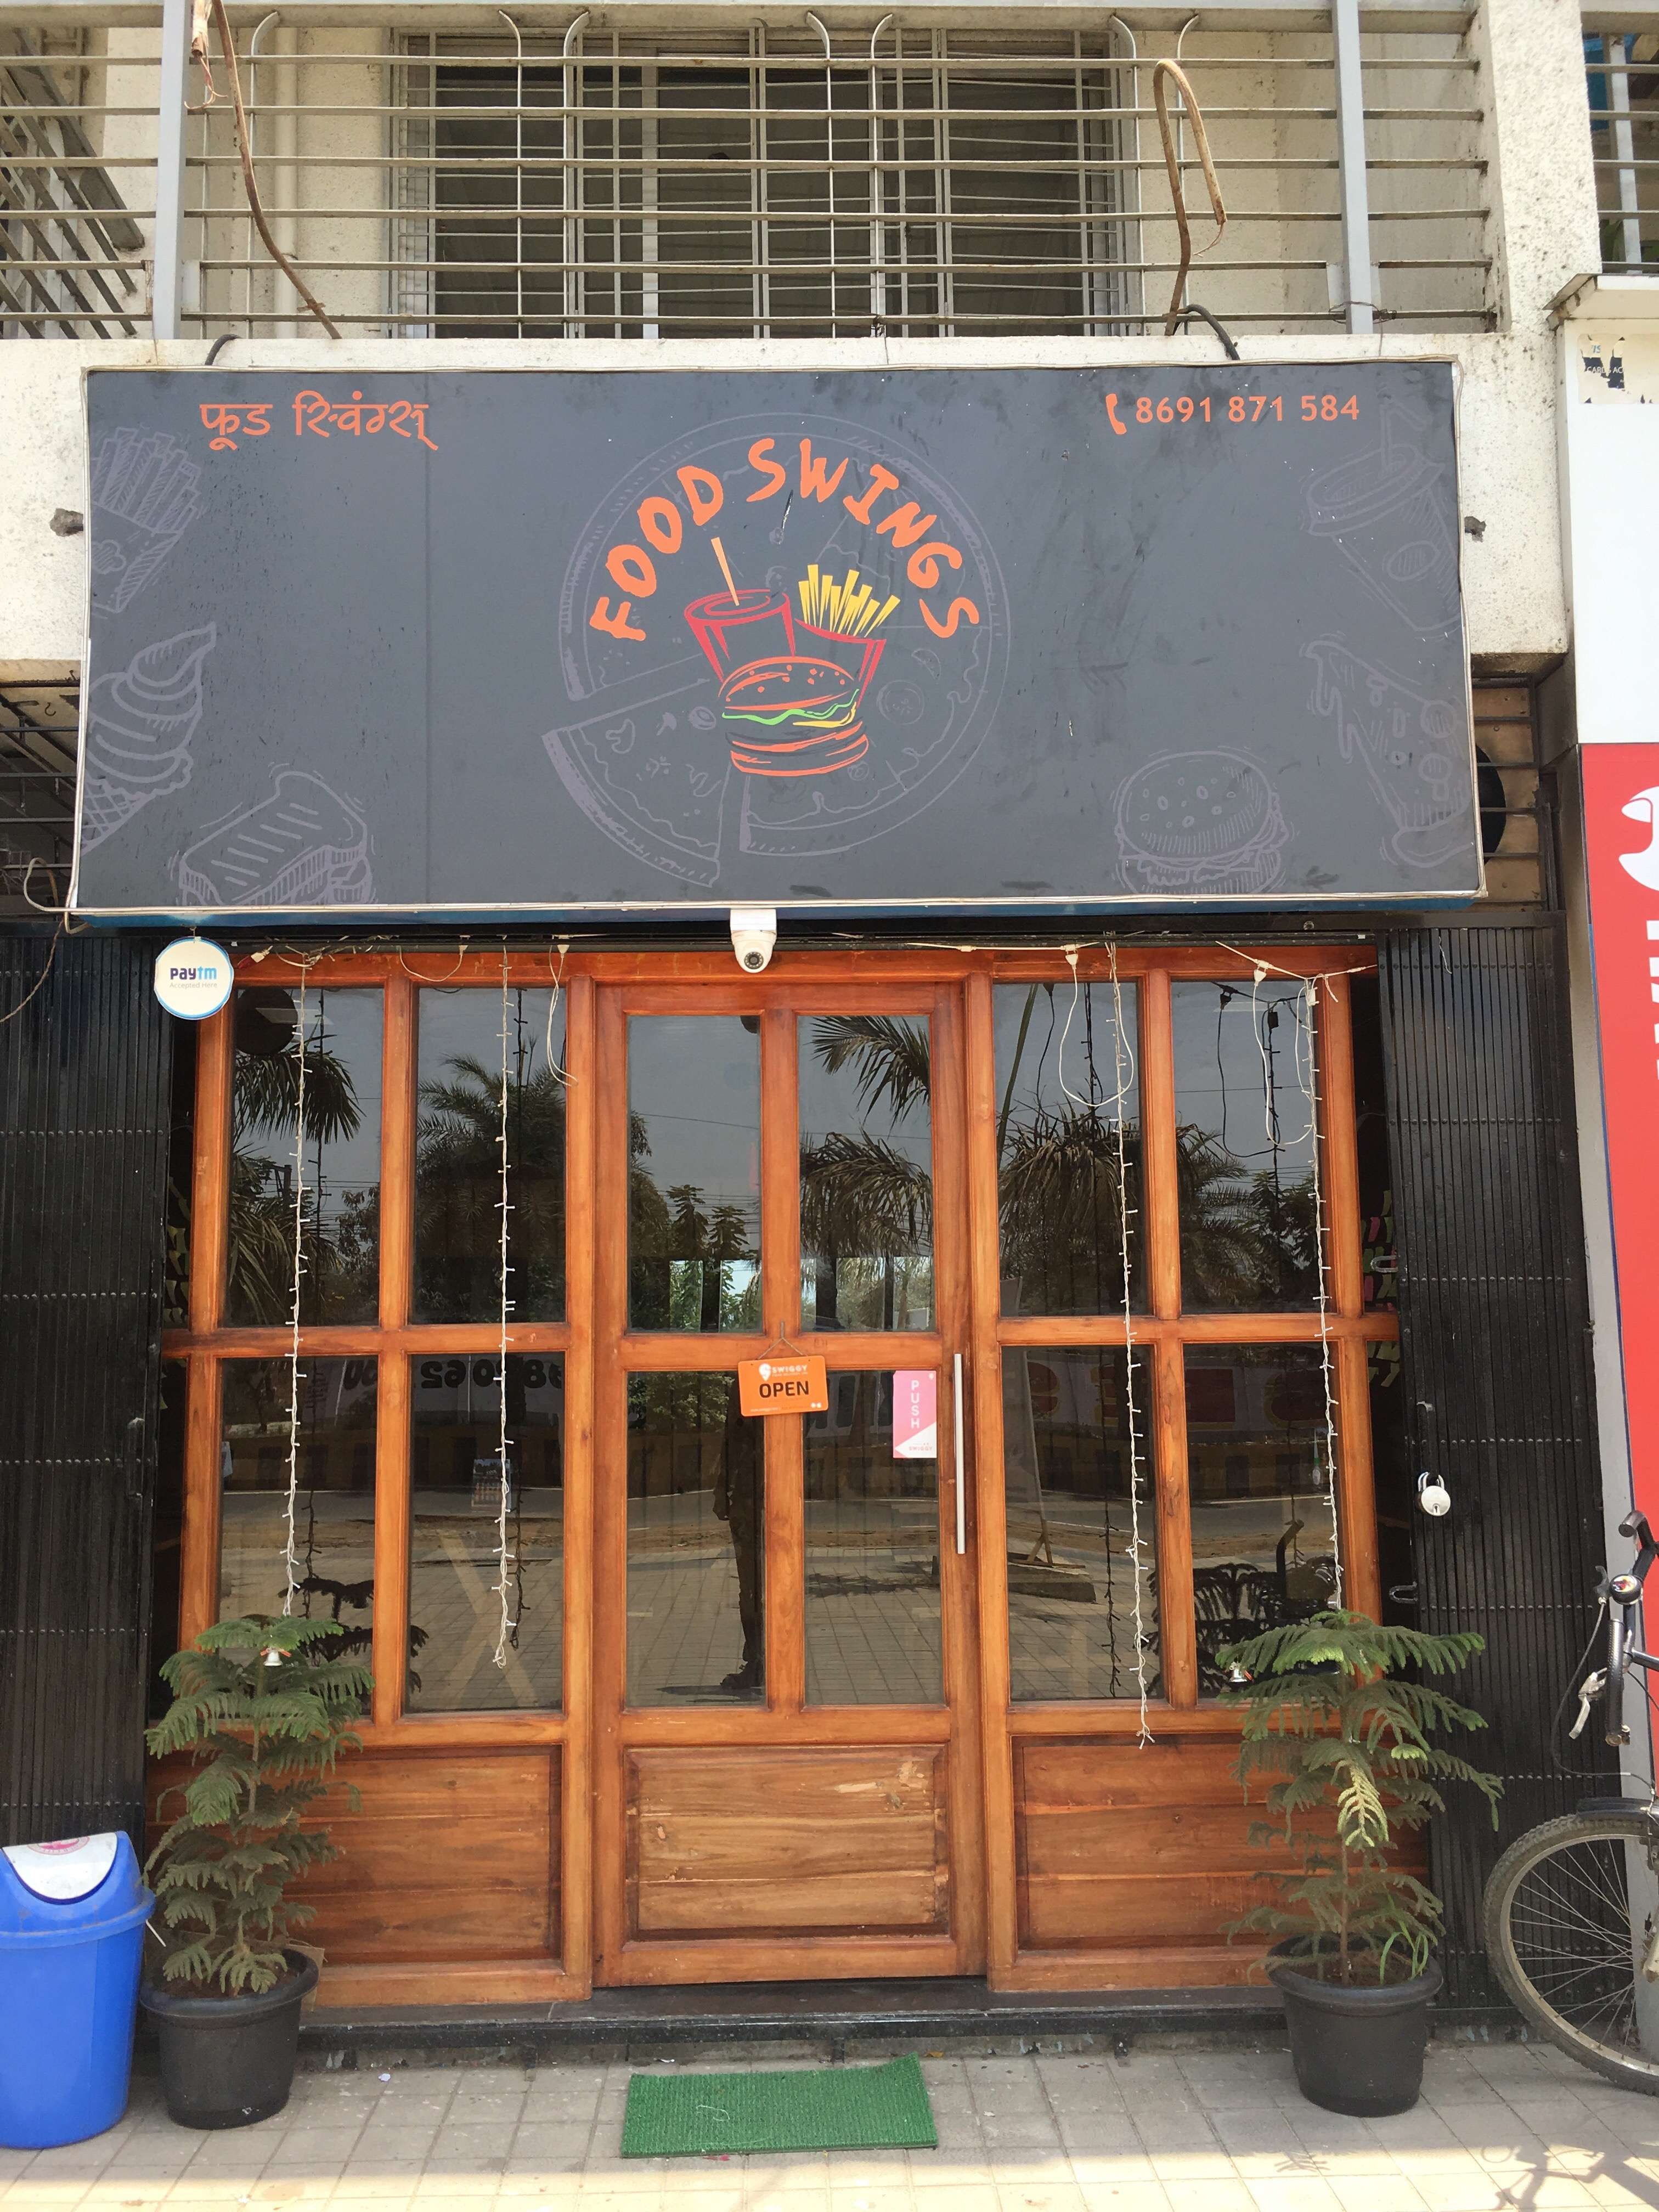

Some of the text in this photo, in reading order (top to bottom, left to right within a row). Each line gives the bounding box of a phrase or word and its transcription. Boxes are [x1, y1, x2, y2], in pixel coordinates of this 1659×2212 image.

[199, 404, 273, 450] फूड
[1136, 394, 1359, 423] 8691 871 584
[589, 437, 980, 641] FOOD SWINGS
[772, 1364, 808, 1373] SWIGGY
[759, 1380, 809, 1398] OPEN
[910, 1379, 920, 1429] PUSH
